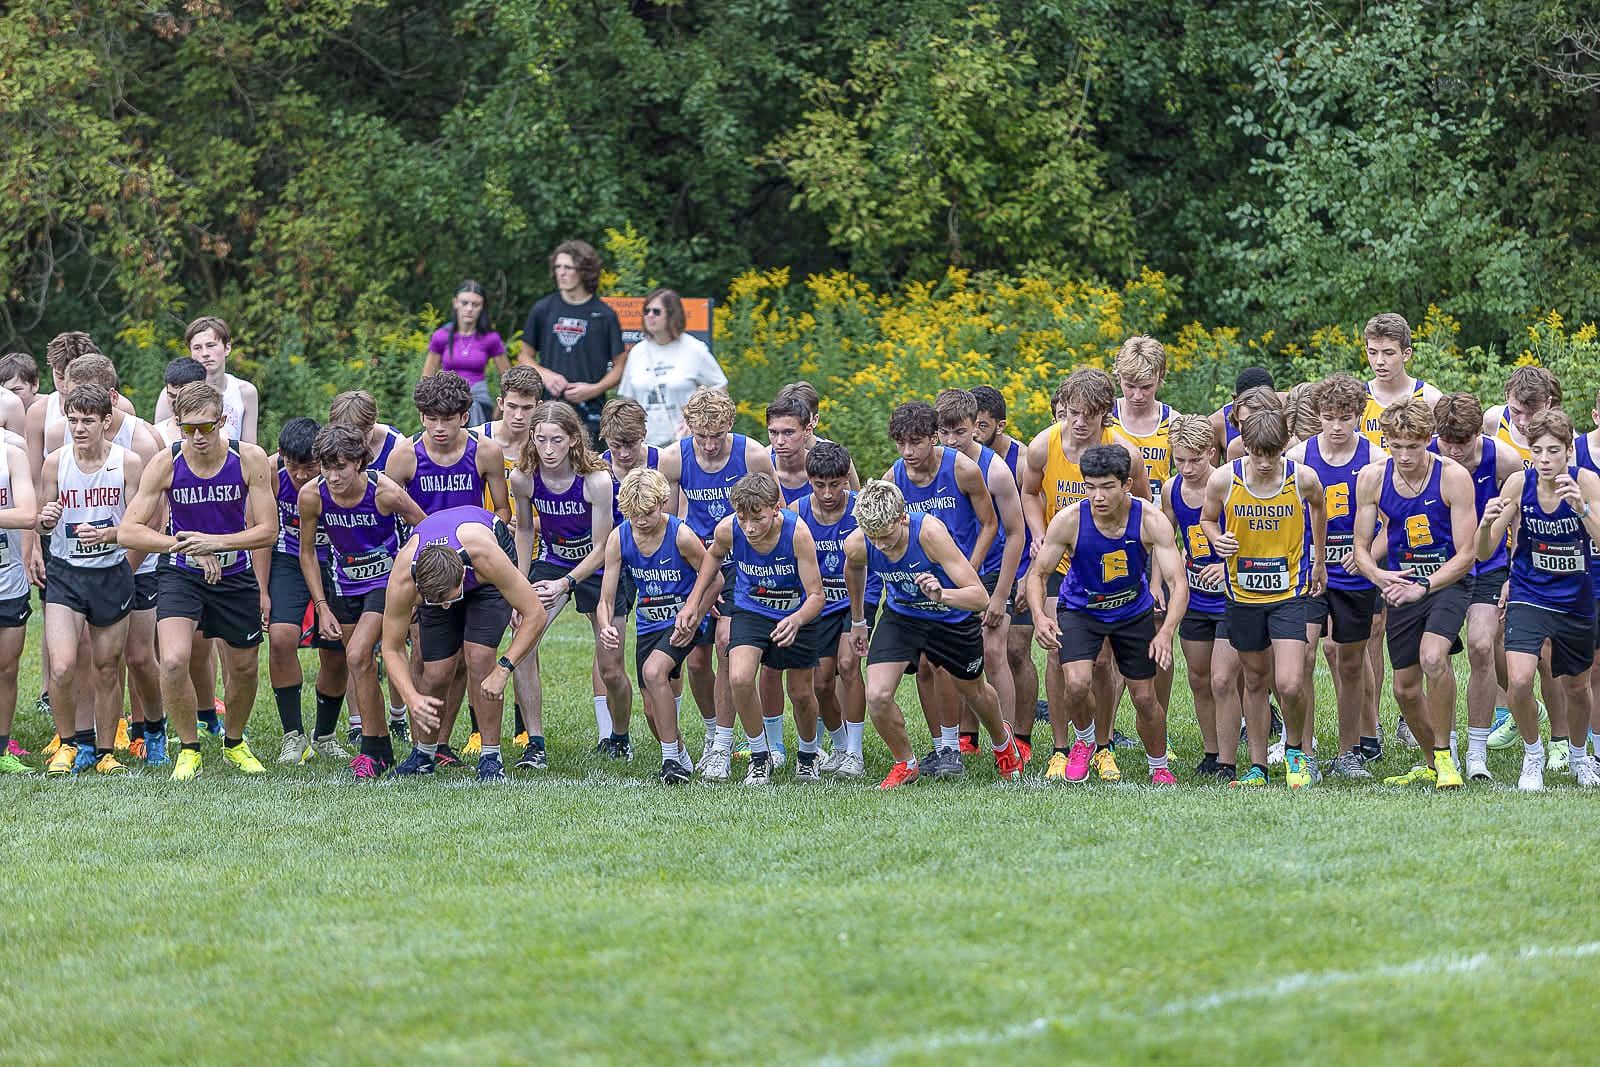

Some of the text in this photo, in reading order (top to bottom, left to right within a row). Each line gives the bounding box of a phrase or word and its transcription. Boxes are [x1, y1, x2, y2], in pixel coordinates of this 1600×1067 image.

[420, 473, 473, 492] ONALASKA
[1057, 480, 1086, 494] MADIS
[61, 487, 120, 508] MT. HOREB
[172, 485, 241, 504] ONALASKA
[534, 498, 586, 515] ONALASKA
[1234, 504, 1293, 517] MADISON
[325, 512, 378, 528] ONALASKA
[1249, 519, 1280, 530] EAST
[1403, 513, 1434, 549] E
[352, 561, 386, 579] 2222
[774, 564, 795, 576] WEST
[1100, 549, 1129, 584] E
[1540, 555, 1577, 571] 5088
[660, 568, 681, 581] WEST
[1245, 574, 1282, 589] 4203
[823, 588, 849, 601] 418
